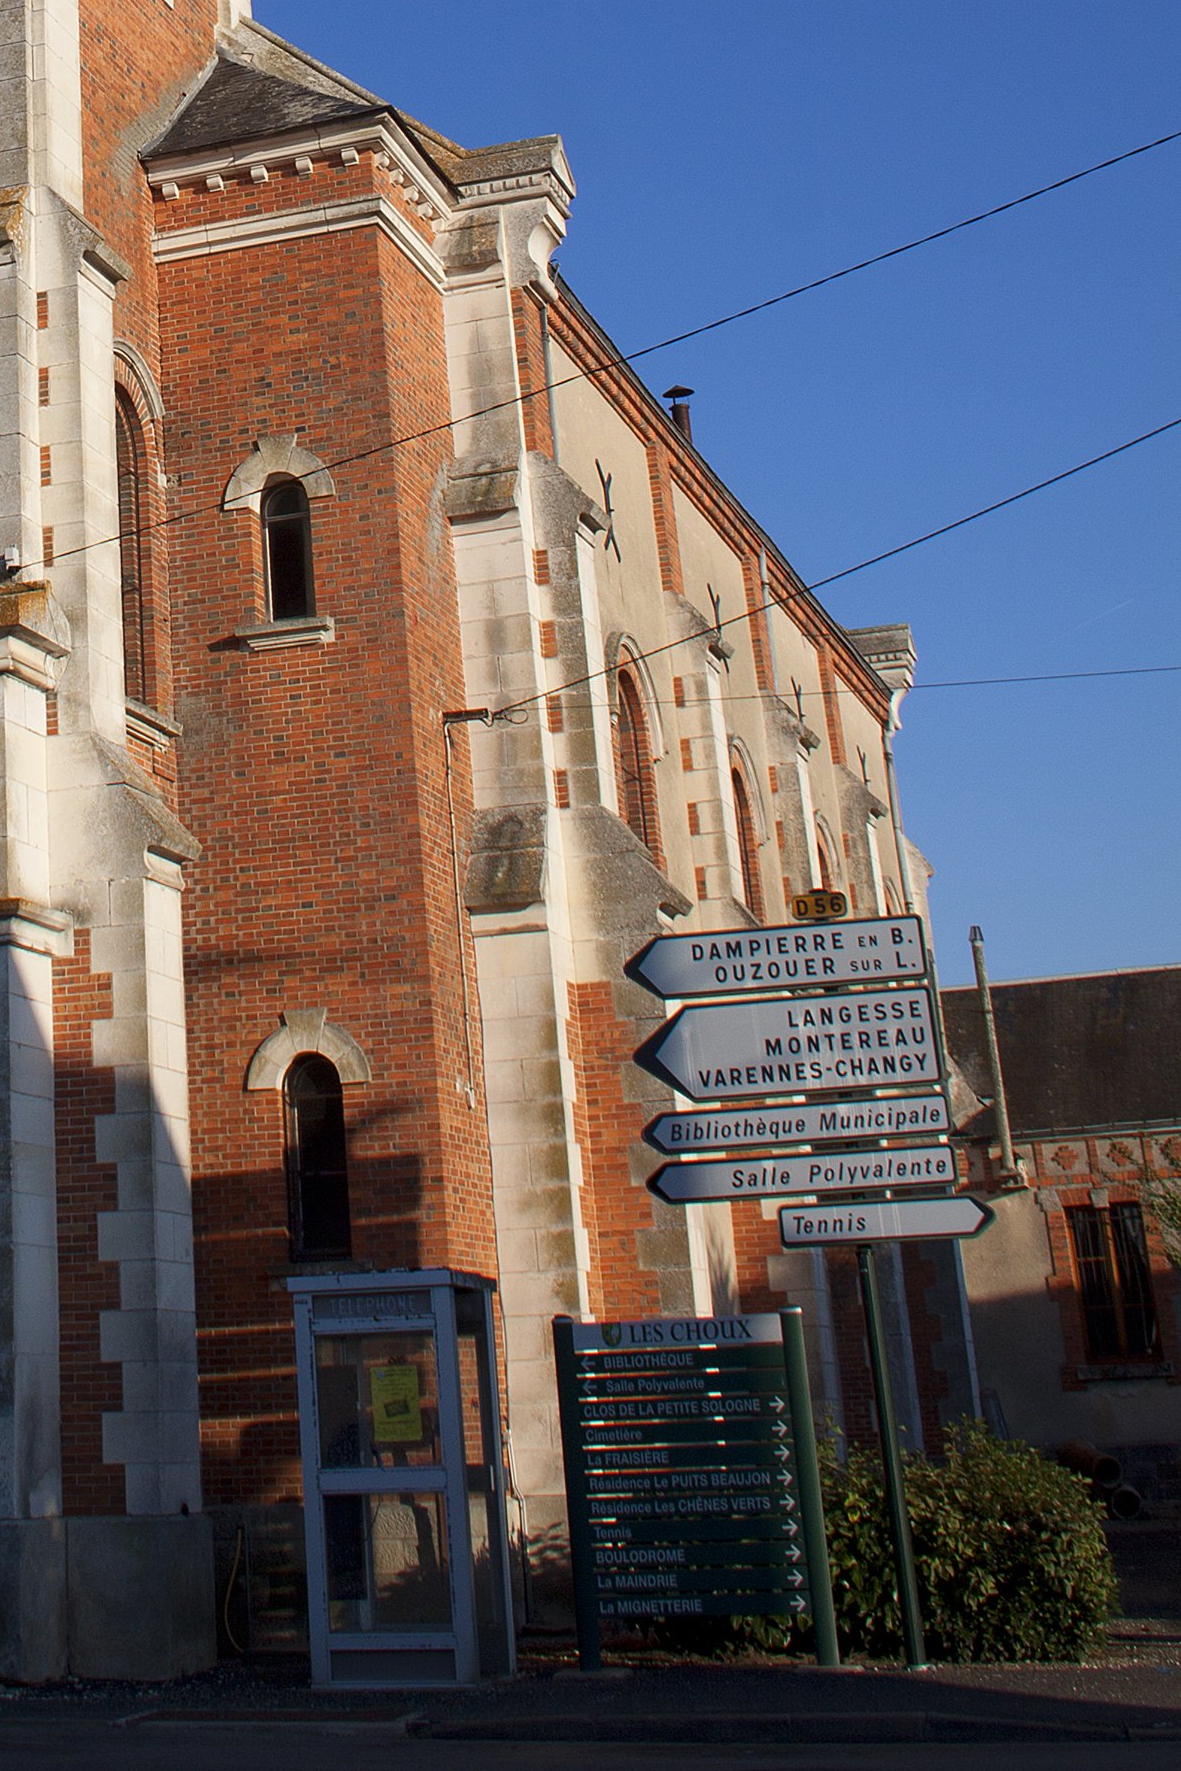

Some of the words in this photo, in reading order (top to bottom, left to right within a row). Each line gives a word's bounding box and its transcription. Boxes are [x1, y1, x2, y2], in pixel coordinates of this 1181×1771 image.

[691, 932, 844, 961] DAMPIERRE
[858, 935, 878, 947] EN
[891, 928, 913, 945] B.
[715, 957, 835, 983] OUZOUER
[850, 959, 882, 972] SUR
[896, 952, 916, 968] L.
[787, 1000, 922, 1028] LANGESSE
[765, 1026, 926, 1056] MONTEREAU
[698, 1054, 927, 1088] VARENNES-CHANGY
[671, 1116, 806, 1142] Bibliothèque
[819, 1105, 941, 1131] Municipale
[731, 1168, 790, 1188] Salle
[809, 1158, 946, 1184] Polyvalente
[793, 1212, 867, 1234] Tennis
[629, 1322, 665, 1344] LES
[671, 1318, 753, 1342] CHOUX
[603, 1352, 694, 1369] BIBLIOTHÈQUE
[606, 1380, 635, 1393] Salle
[638, 1377, 704, 1392] Polyvalente
[584, 1405, 616, 1418] CLOS
[620, 1404, 636, 1416] DE
[639, 1403, 655, 1415] LA
[658, 1401, 699, 1414] PETITE
[701, 1398, 761, 1412] SOLOGNE
[585, 1428, 643, 1441] Cimetière
[587, 1454, 602, 1466] La
[605, 1450, 669, 1465] FRAISIÈRE
[589, 1476, 651, 1490] Résidence
[654, 1476, 668, 1488] Le
[672, 1474, 708, 1488] PUITS
[711, 1472, 770, 1486] BEAUJON
[591, 1501, 651, 1515] Résidence
[655, 1500, 675, 1513] Les
[678, 1496, 728, 1512] CHÊNES
[731, 1497, 771, 1511] VERTS
[595, 1526, 631, 1539] Tennis
[596, 1549, 685, 1564] BOULODROME
[598, 1575, 612, 1588] La
[615, 1574, 677, 1588] MAINDRIE
[599, 1601, 614, 1614] La
[617, 1598, 703, 1614] MIGNETTERIE
